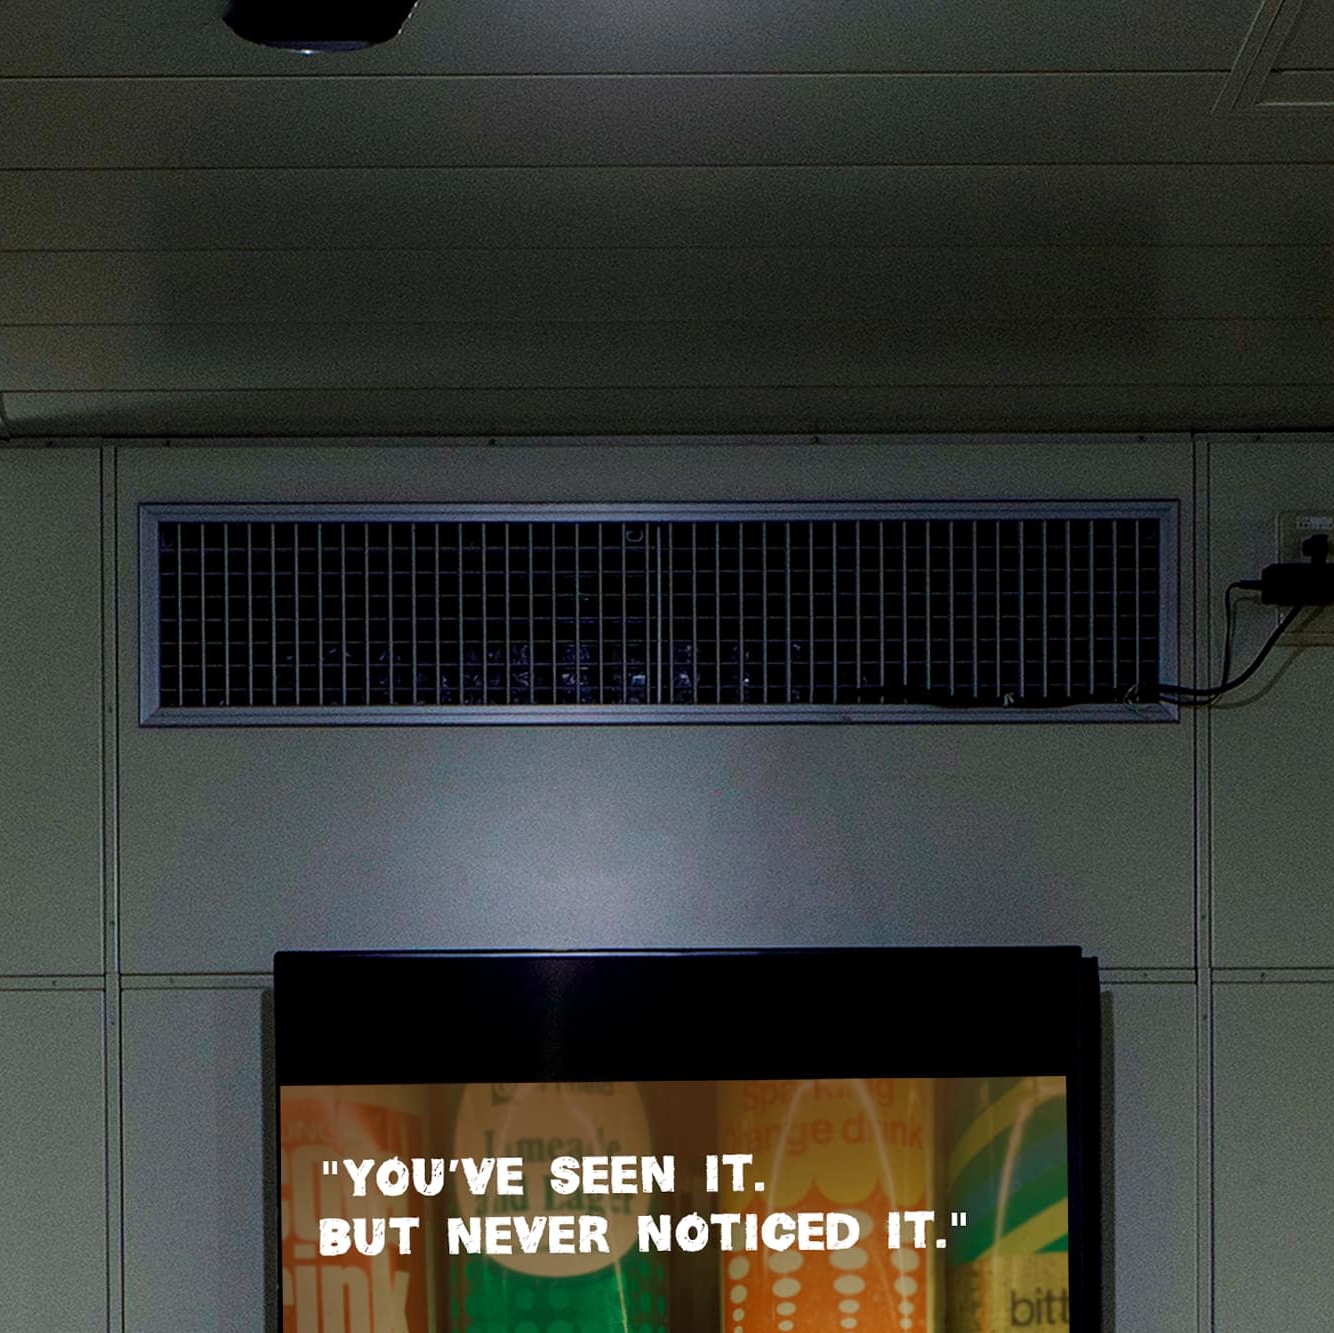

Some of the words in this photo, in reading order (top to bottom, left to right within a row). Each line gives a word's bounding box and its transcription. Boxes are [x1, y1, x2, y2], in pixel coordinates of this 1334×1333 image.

[322, 1156, 524, 1197] "YOU'VE
[550, 1154, 676, 1195] SEEN
[706, 1153, 765, 1193] IT.
[319, 1217, 420, 1257] BUT
[447, 1215, 611, 1255] NEVER
[638, 1211, 861, 1252] NOTICED
[887, 1210, 969, 1250] IT."
